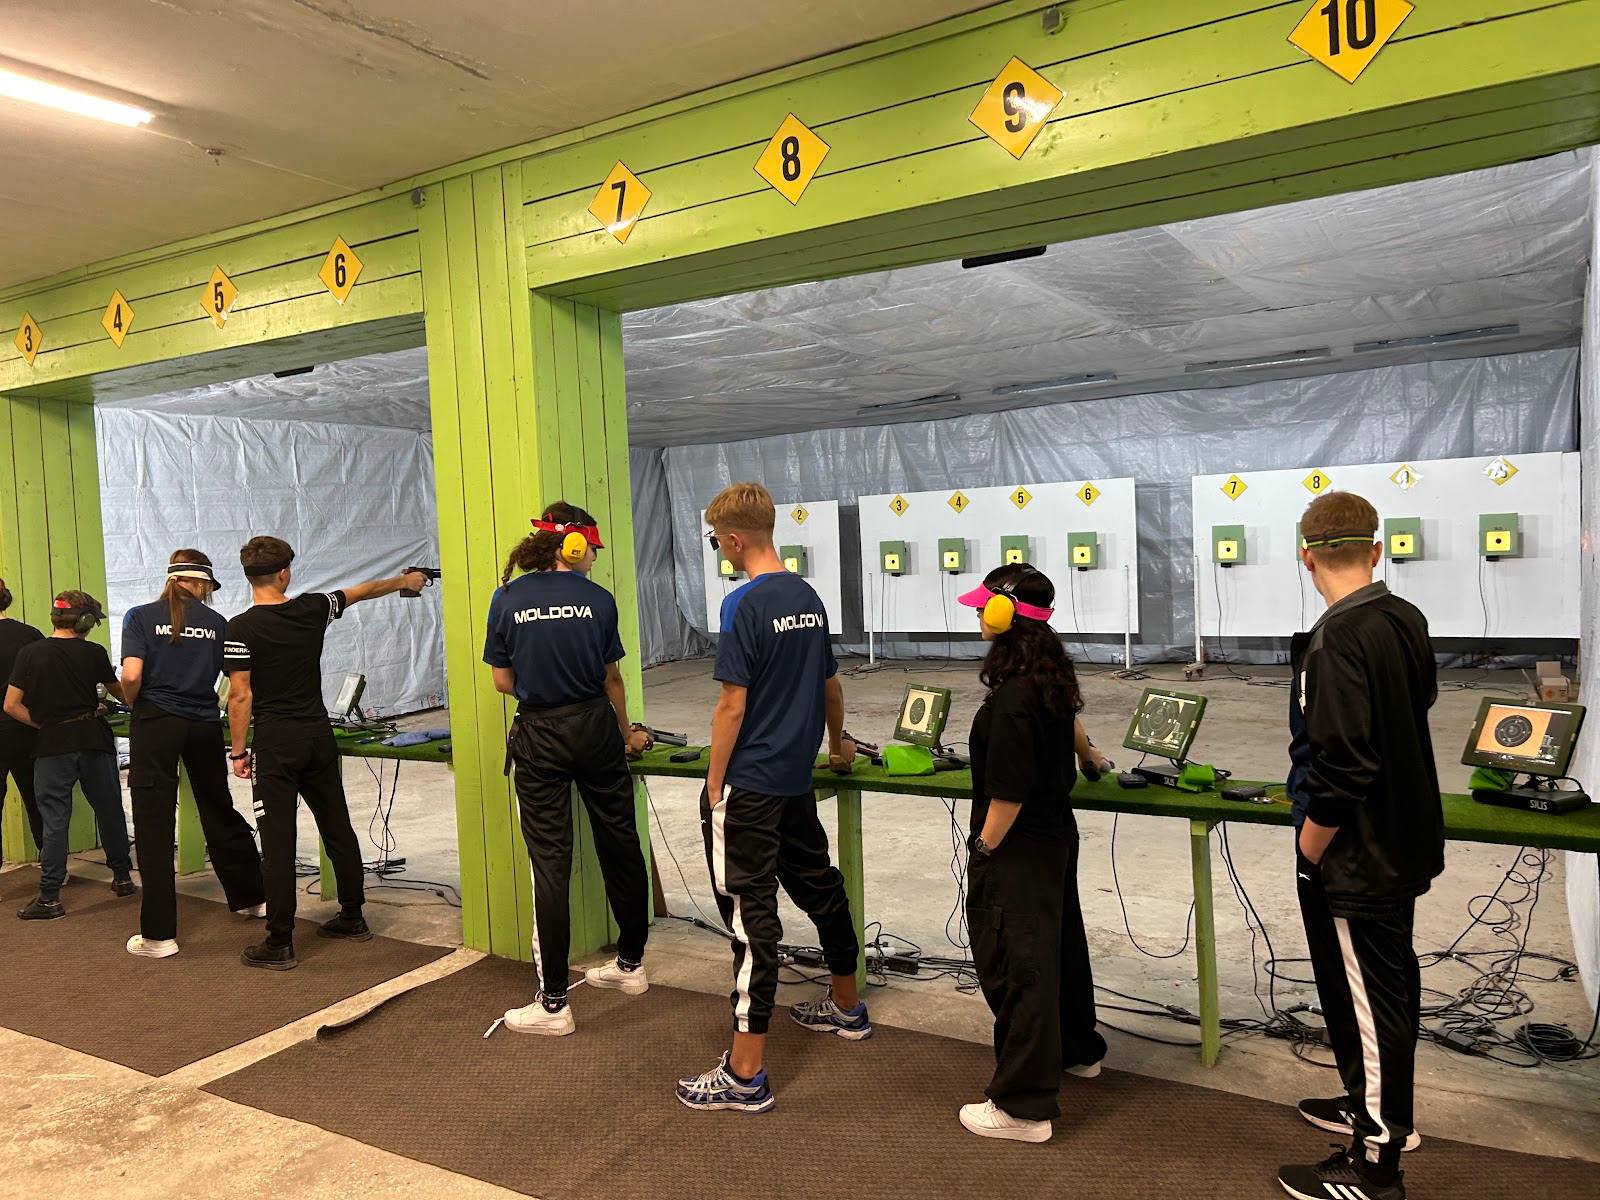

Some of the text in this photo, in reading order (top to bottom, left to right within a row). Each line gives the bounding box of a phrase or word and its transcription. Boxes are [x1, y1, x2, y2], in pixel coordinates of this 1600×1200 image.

[1320, 0, 1376, 56] 10
[1002, 81, 1027, 133] 9
[781, 135, 801, 182] 8
[611, 180, 626, 222] 7
[334, 253, 347, 288] 6
[213, 281, 225, 314] 5
[113, 303, 123, 333] 4
[24, 325, 33, 353] 3
[1229, 480, 1238, 495] 7
[1312, 475, 1321, 489] 8
[955, 496, 962, 508] 4
[1017, 491, 1024, 504] 5
[1084, 487, 1092, 501] 6
[797, 509, 803, 521] 2
[895, 499, 902, 512] 3
[514, 605, 593, 625] MOLDOVA
[772, 613, 824, 633] MOLDOV
